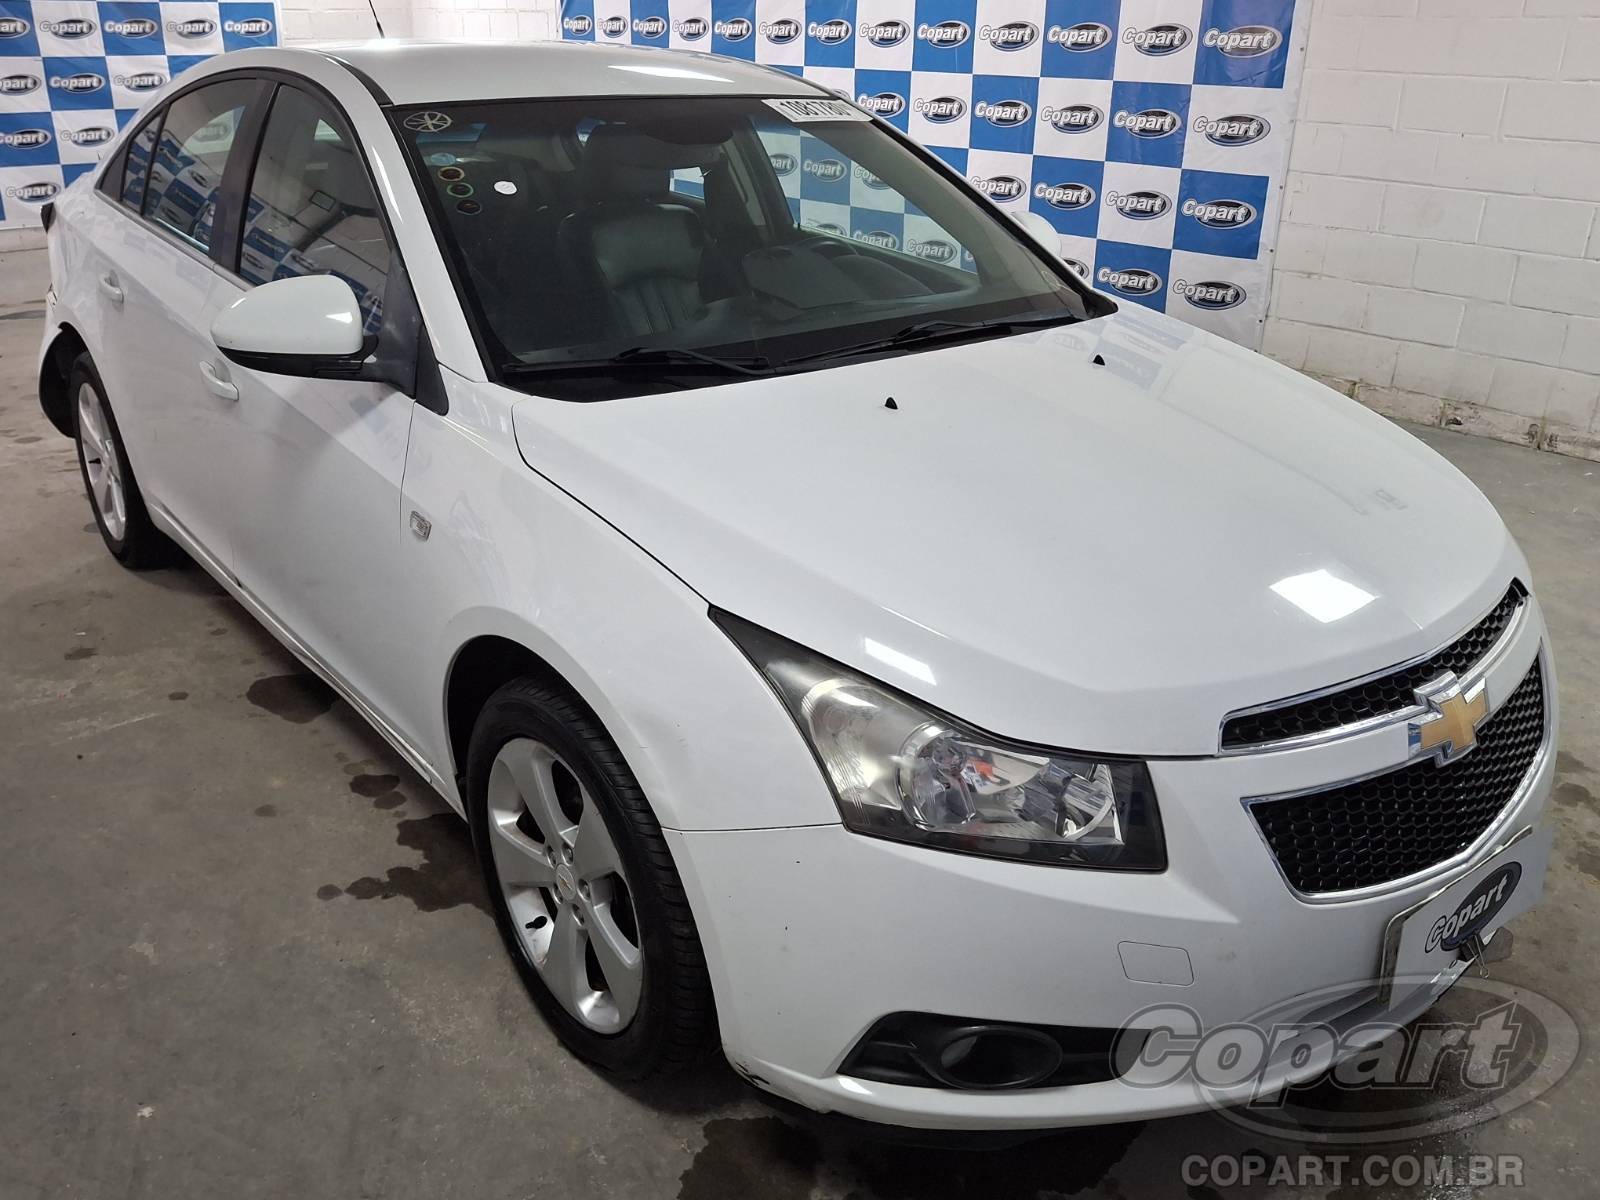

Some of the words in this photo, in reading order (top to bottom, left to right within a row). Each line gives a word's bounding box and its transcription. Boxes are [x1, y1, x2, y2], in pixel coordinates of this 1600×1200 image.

[40, 21, 89, 36] Copart
[104, 20, 152, 35] Copart
[166, 22, 211, 35] Copart
[224, 20, 267, 35] Copart
[564, 19, 590, 32] Copart
[598, 18, 625, 33] Copart
[632, 19, 664, 34] Copart
[673, 20, 704, 35] Copart
[714, 20, 748, 38] Copart
[759, 22, 797, 38] Copart
[808, 22, 847, 39] Copart
[859, 23, 903, 41] Copart
[917, 23, 965, 42] Copart
[978, 25, 1031, 45] Copart
[1047, 25, 1104, 48] Copart
[1122, 27, 1185, 48] Copart
[1203, 28, 1274, 53] Copart
[49, 76, 99, 90] Copart
[112, 75, 160, 89] Copart
[858, 94, 900, 113] Copart
[914, 98, 960, 117] Copart
[975, 101, 1026, 121] Copart
[1041, 106, 1097, 127] Copart
[1113, 110, 1174, 132] Copart
[61, 129, 108, 144] Copart
[1193, 116, 1263, 138] Copart
[803, 160, 842, 176] Copart
[6, 186, 54, 200] Copart
[1034, 182, 1089, 205] Copart
[1106, 191, 1165, 212] Copart
[1181, 198, 1247, 223] Copart
[907, 239, 952, 258] Copart
[1097, 267, 1155, 290] Copart
[1173, 279, 1237, 303] Copart
[1425, 874, 1508, 953] Copart
